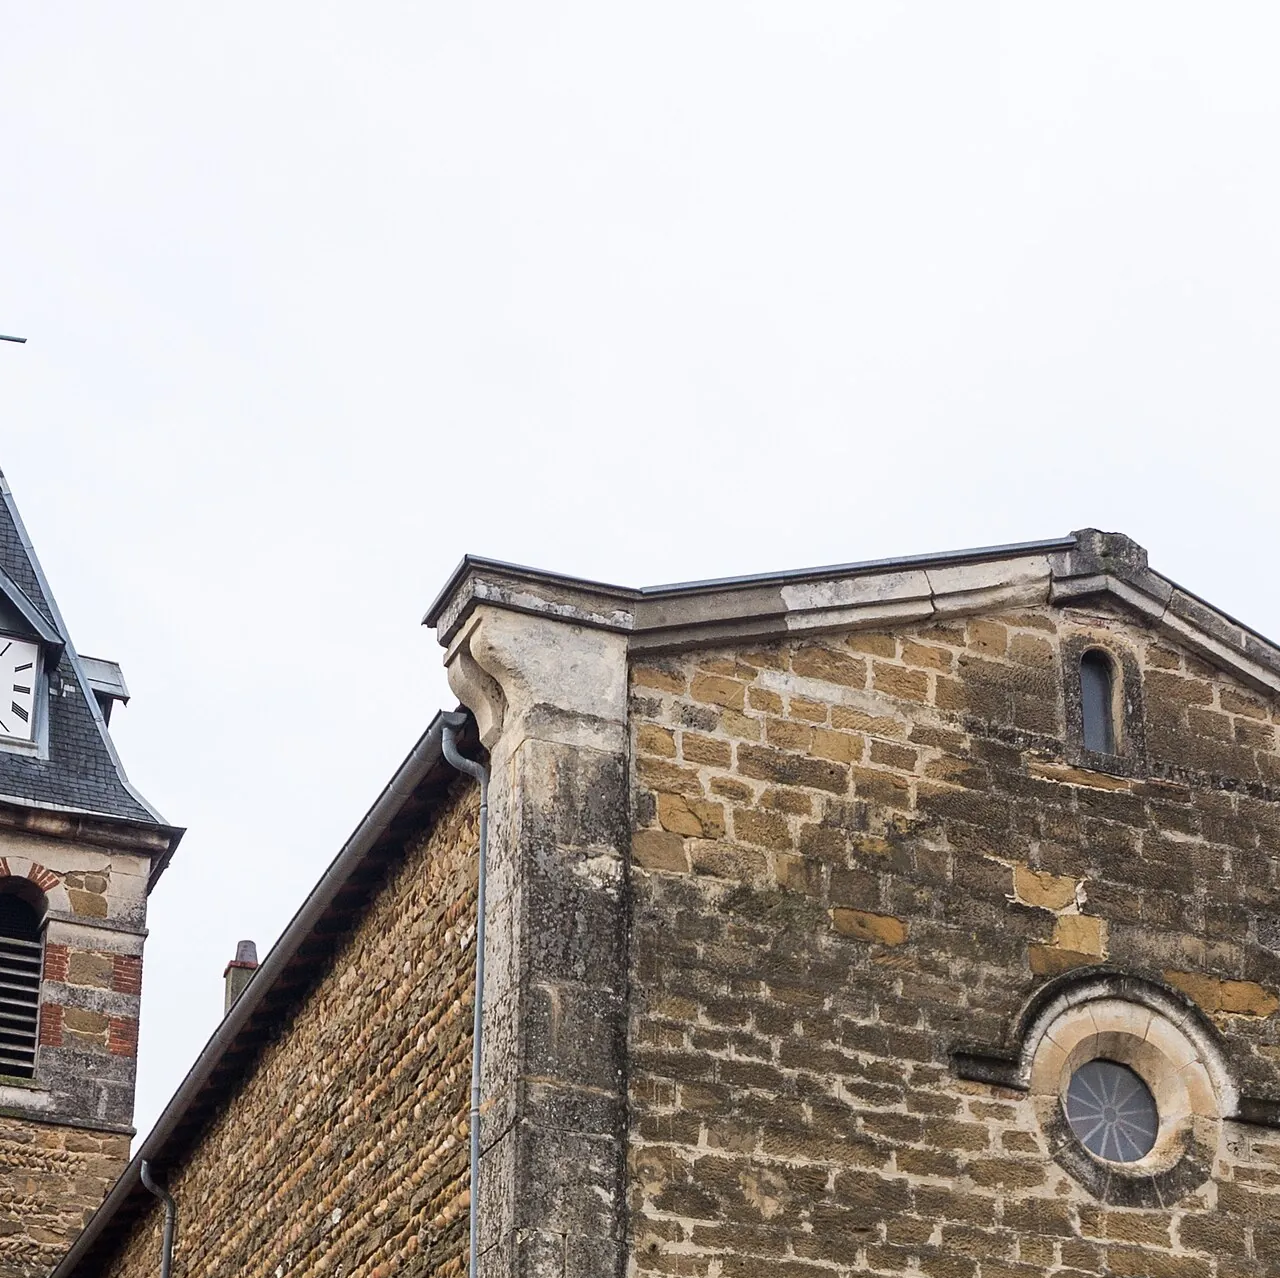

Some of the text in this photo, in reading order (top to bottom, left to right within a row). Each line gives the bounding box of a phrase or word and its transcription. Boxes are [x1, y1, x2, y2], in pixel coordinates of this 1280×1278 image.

[0, 641, 13, 657] I
[14, 662, 33, 673] II
[13, 684, 31, 695] III
